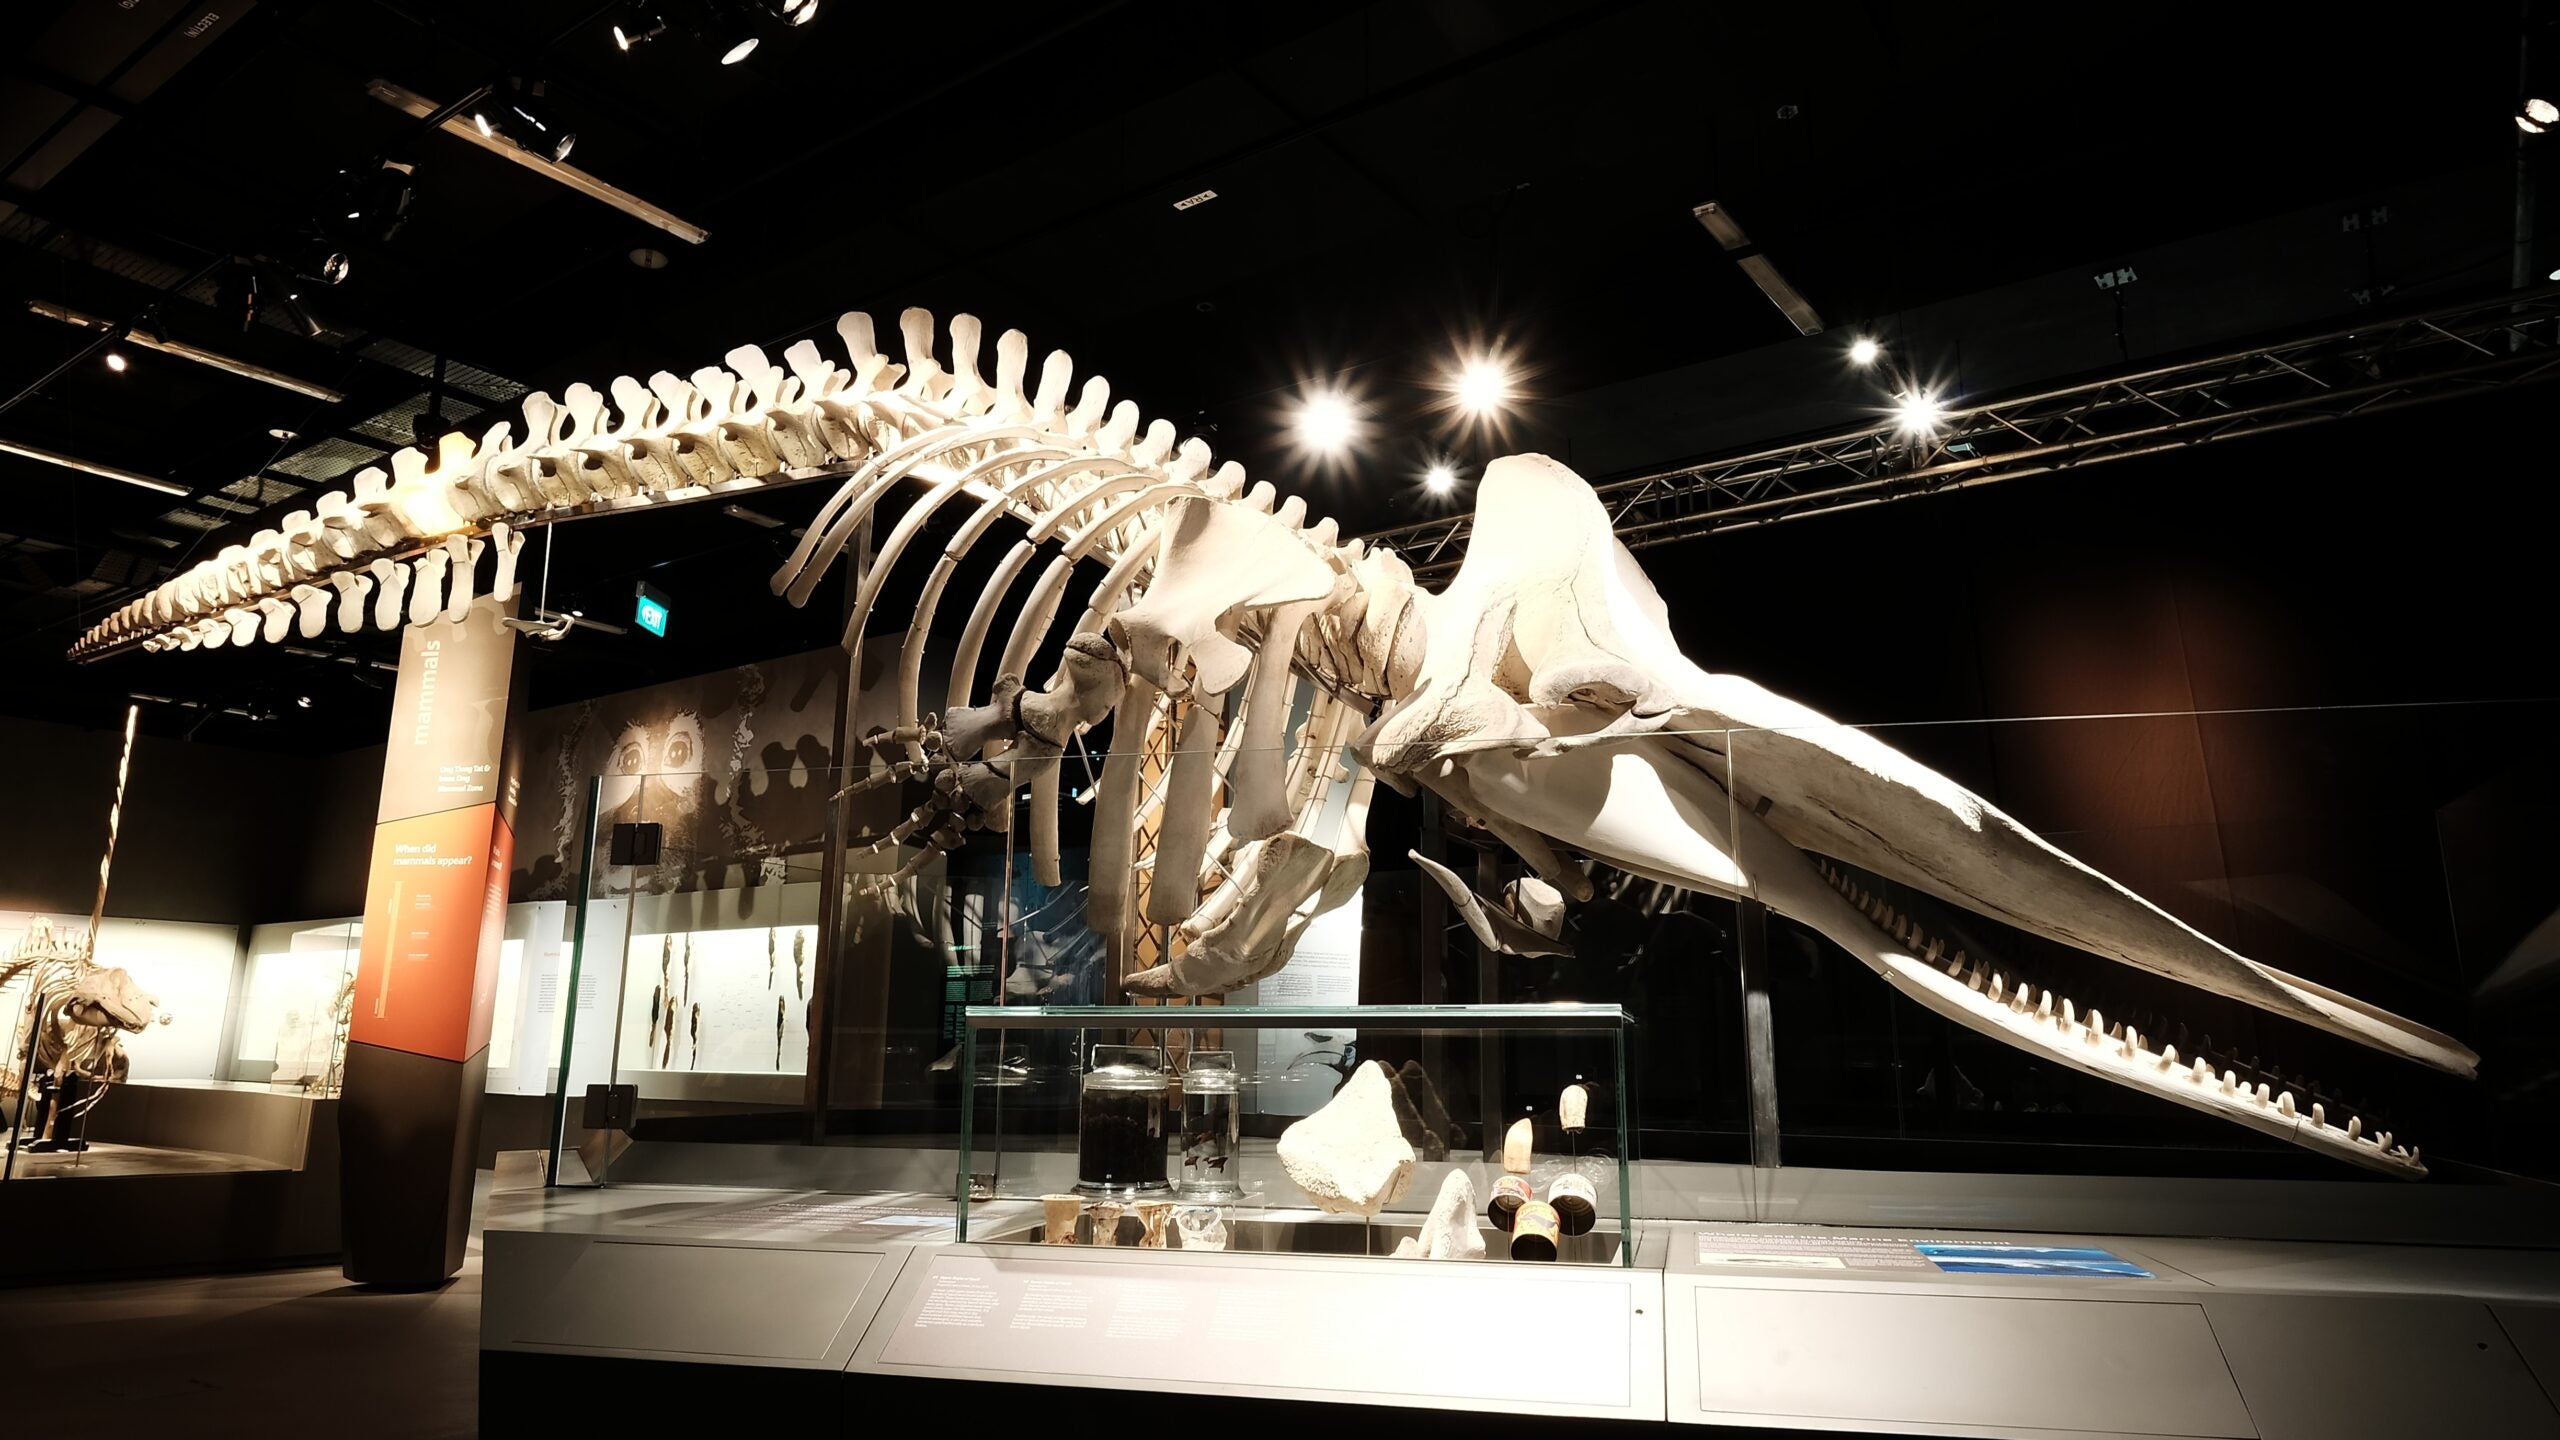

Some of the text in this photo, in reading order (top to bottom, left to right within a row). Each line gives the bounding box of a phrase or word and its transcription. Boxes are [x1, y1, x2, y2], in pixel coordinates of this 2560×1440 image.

[414, 640, 441, 745] mammals
[395, 843, 436, 853] When did
[393, 855, 473, 868] mammals appear?
